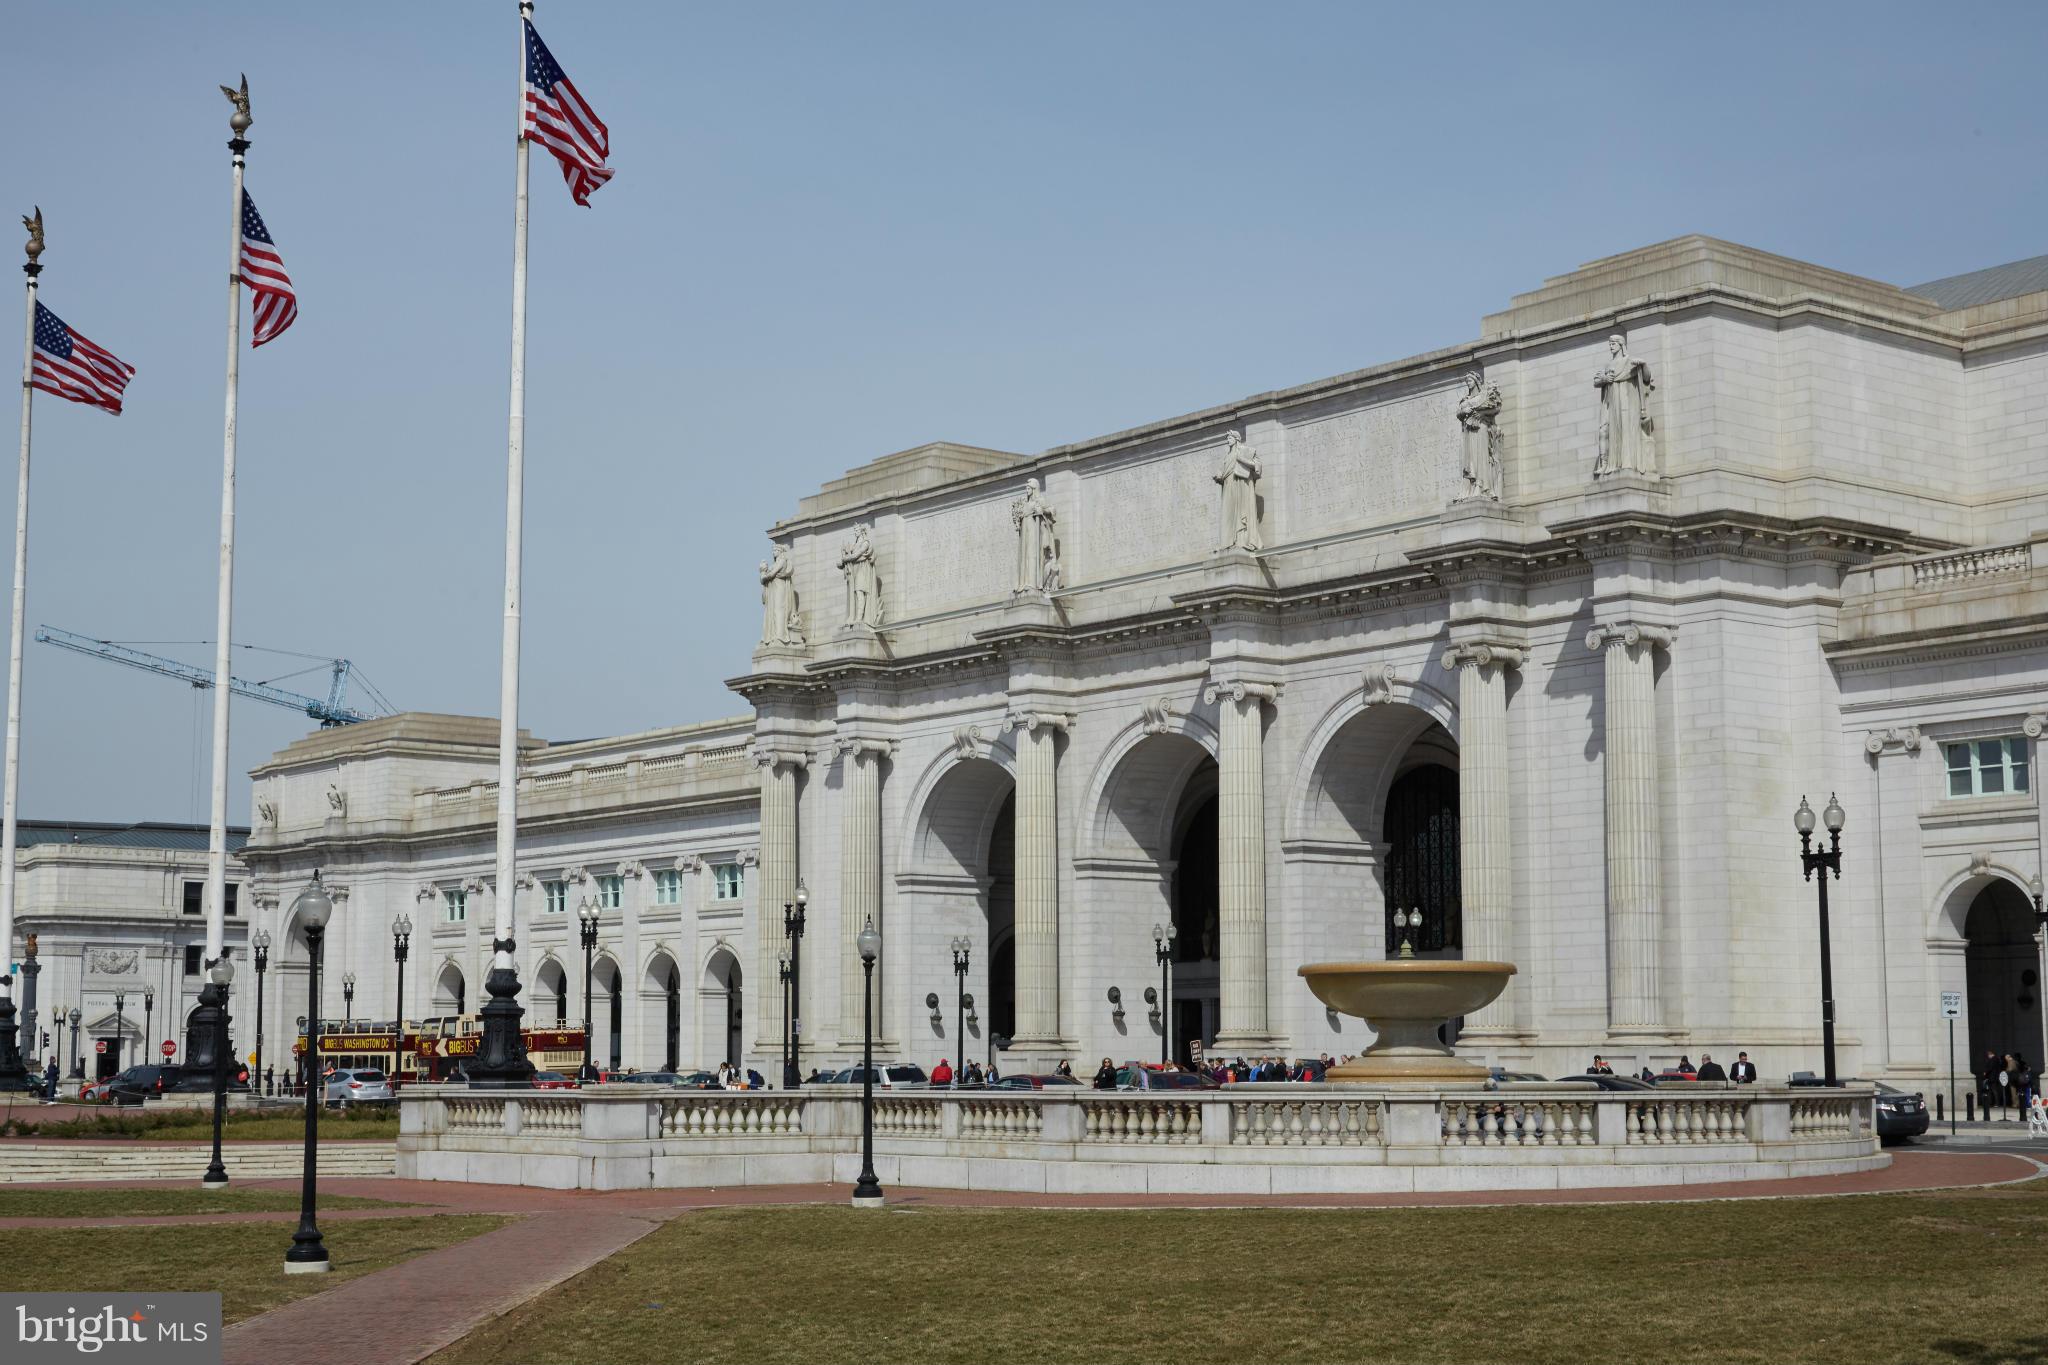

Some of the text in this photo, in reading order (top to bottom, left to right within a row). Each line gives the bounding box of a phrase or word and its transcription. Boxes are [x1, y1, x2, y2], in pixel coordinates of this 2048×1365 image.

[162, 1044, 175, 1052] STOP
[344, 1038, 380, 1049] WASHINGTON
[381, 1037, 390, 1048] DC
